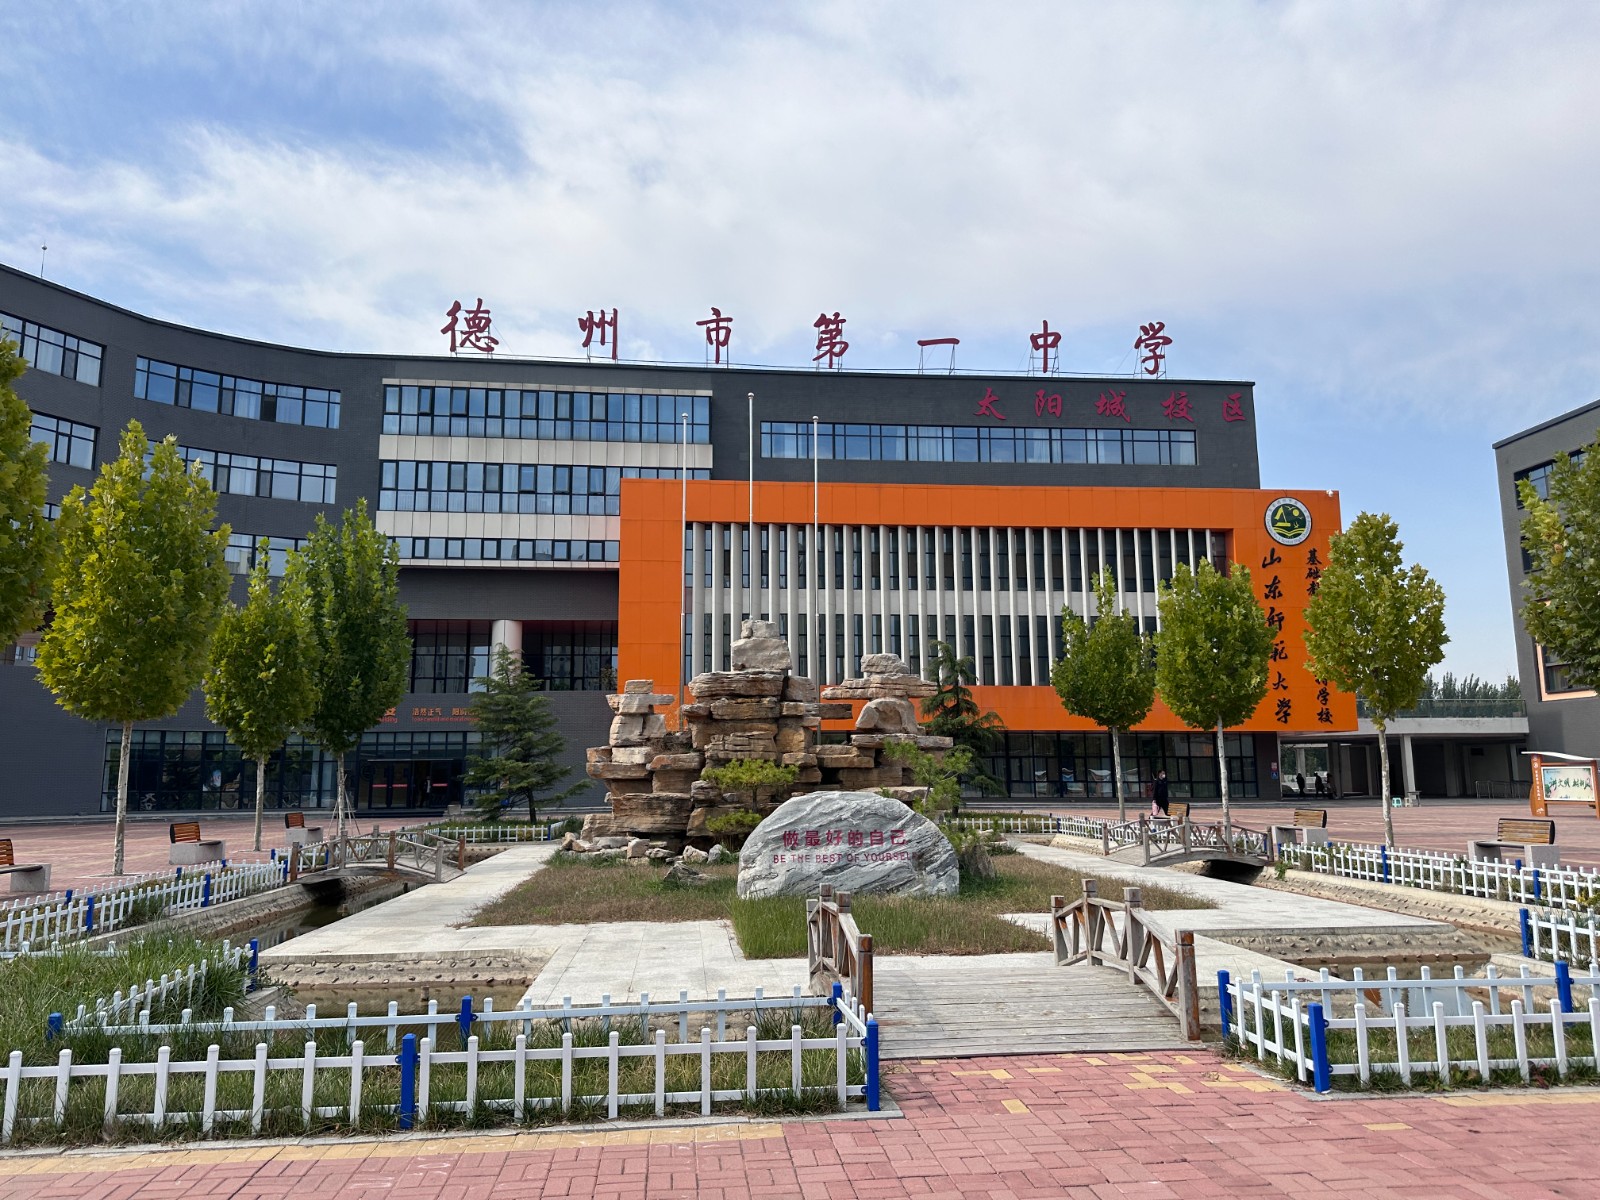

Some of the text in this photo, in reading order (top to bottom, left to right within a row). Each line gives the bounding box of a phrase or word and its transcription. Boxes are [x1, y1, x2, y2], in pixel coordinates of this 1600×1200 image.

[441, 298, 1172, 375] 德州市第一中学
[973, 387, 1246, 423] 太阳城校区
[782, 829, 908, 847] 做最好的自己
[773, 854, 786, 864] BE
[791, 853, 810, 864] THE
[816, 853, 842, 864] BEST
[847, 853, 860, 863] OF
